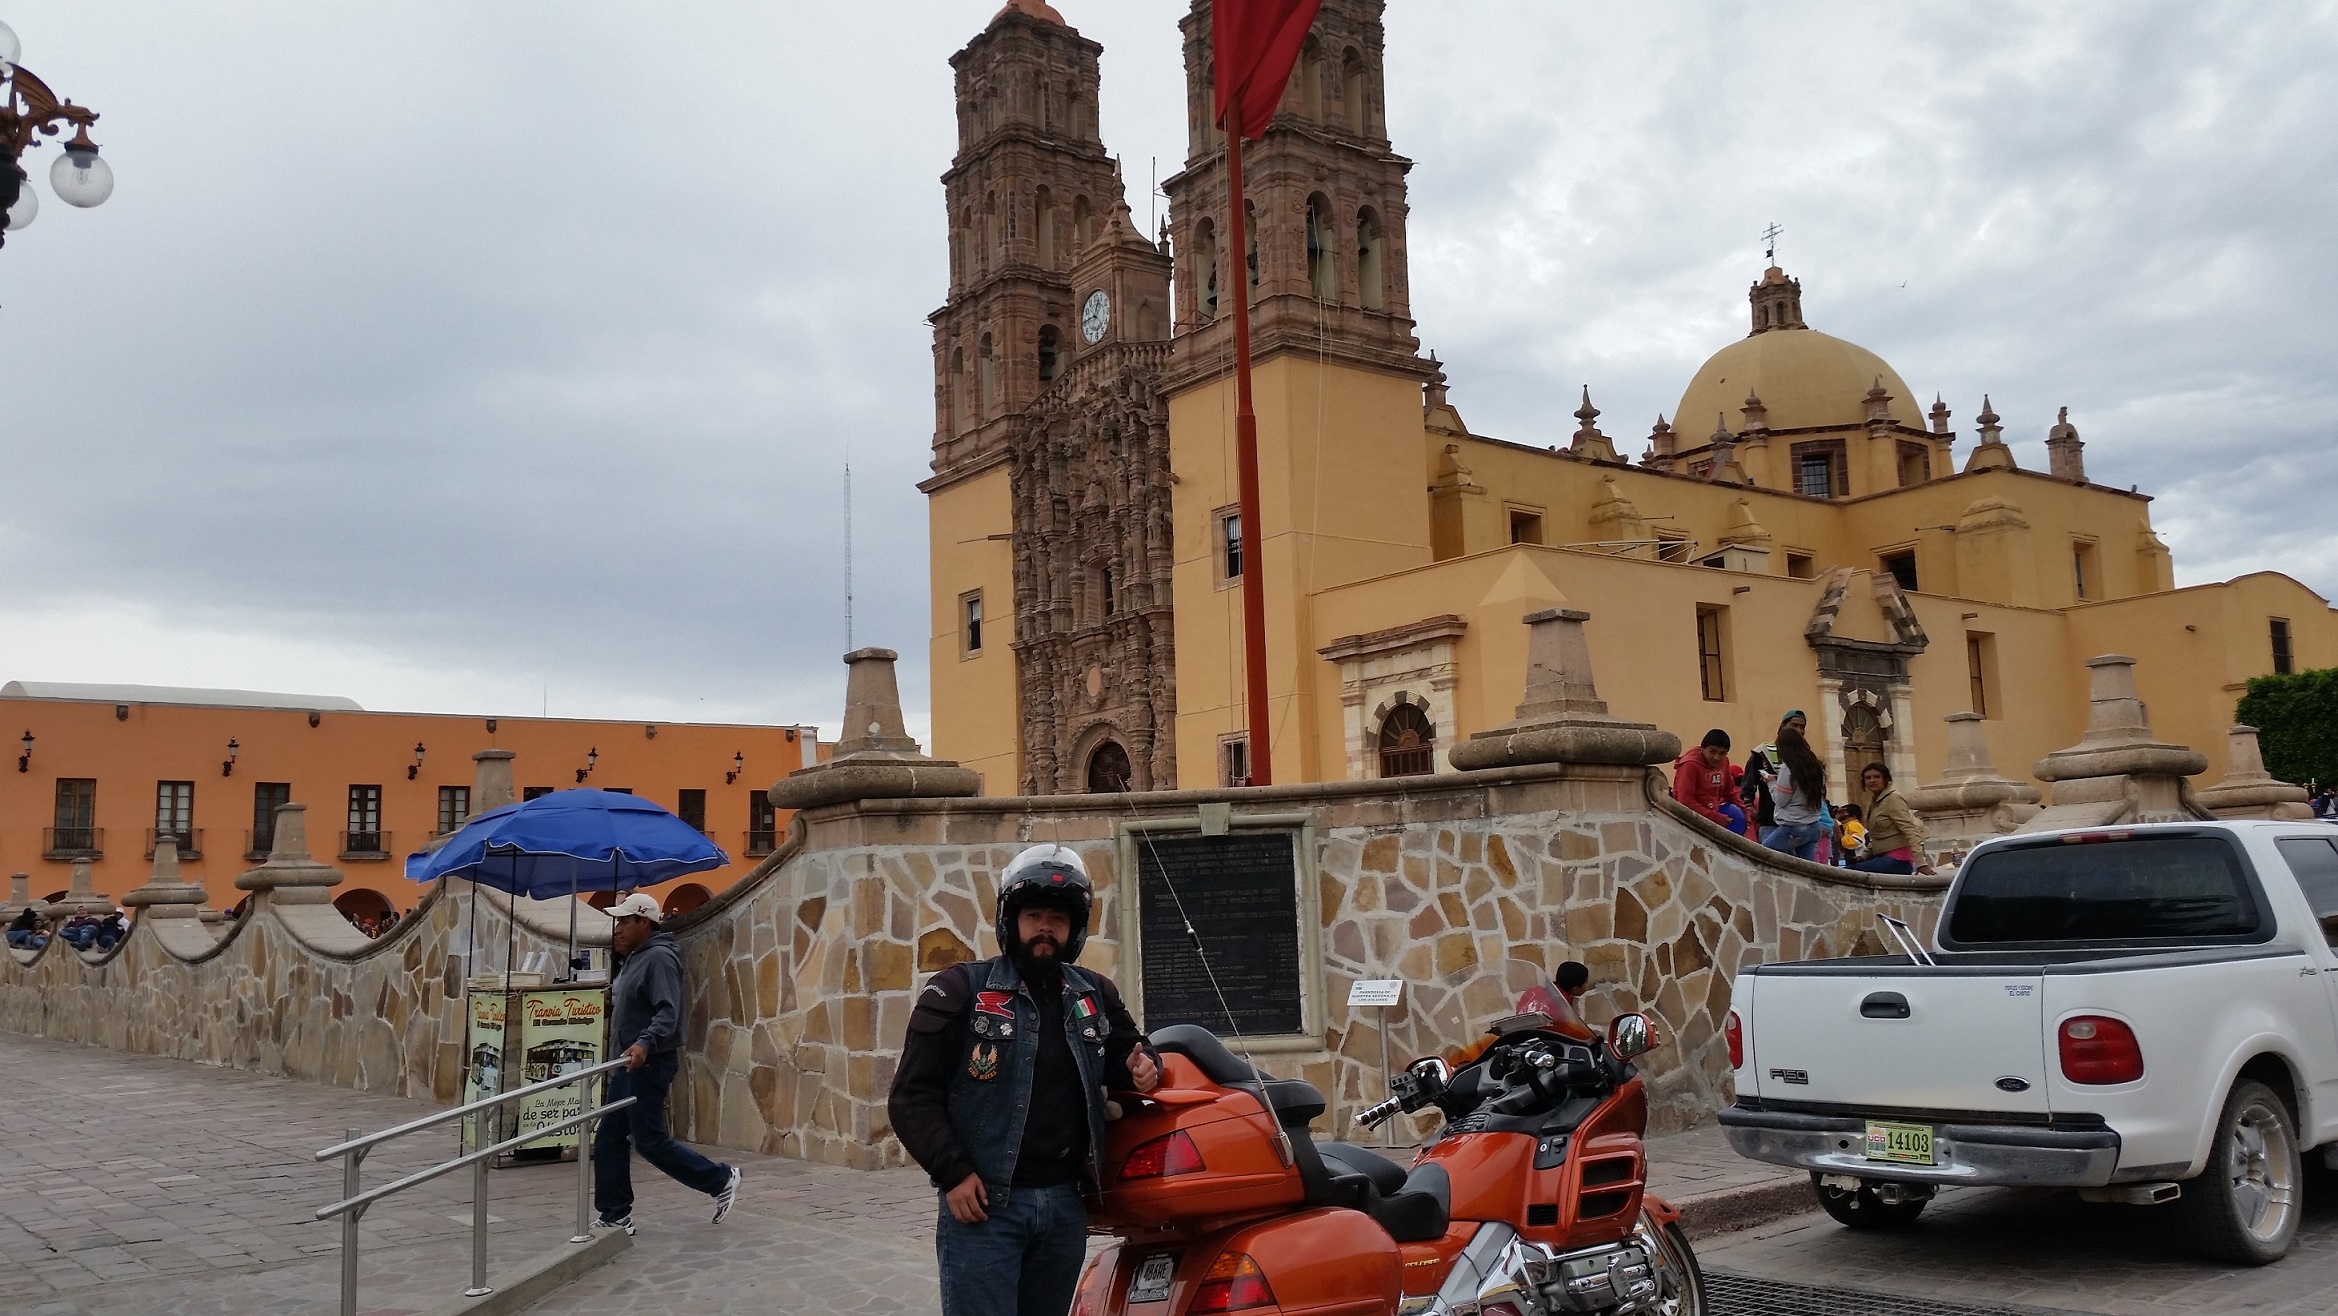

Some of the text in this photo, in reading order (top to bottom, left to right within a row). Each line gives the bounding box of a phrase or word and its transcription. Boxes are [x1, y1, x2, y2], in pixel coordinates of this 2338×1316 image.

[523, 1106, 537, 1120] de
[541, 1108, 559, 1119] ser
[1888, 1132, 1928, 1152] 14103
